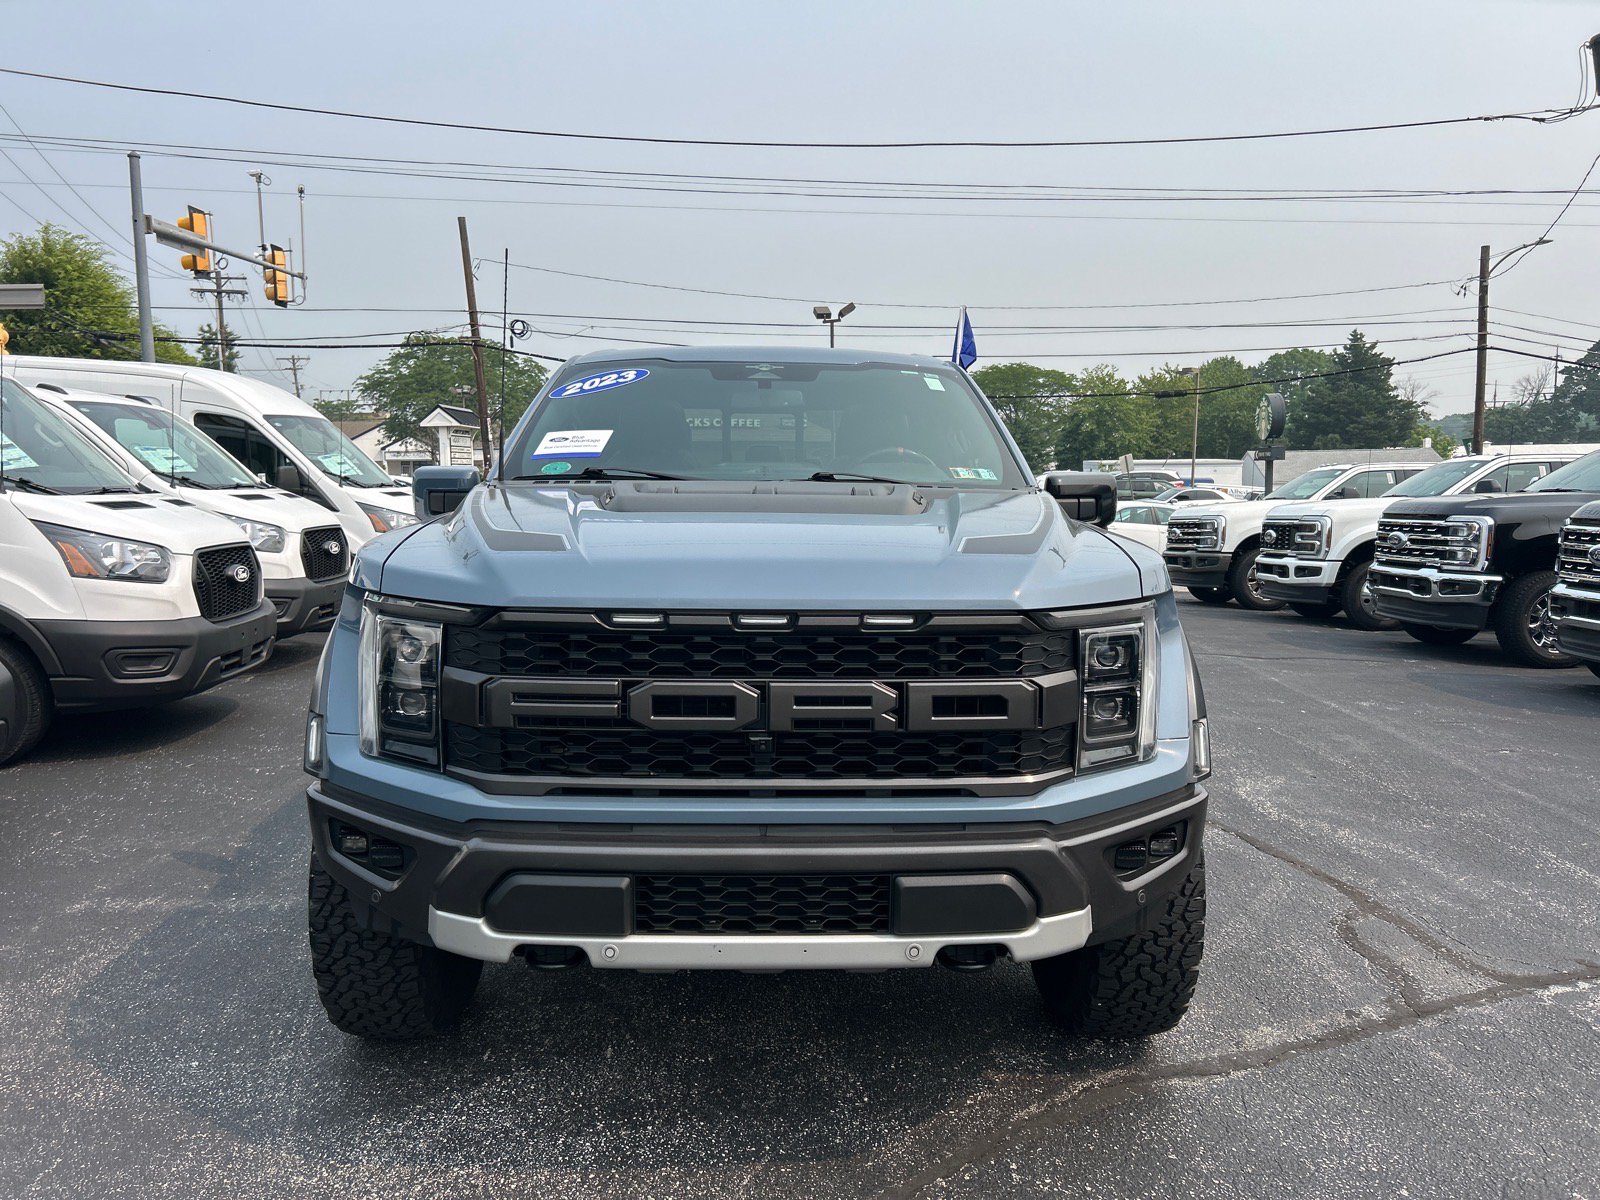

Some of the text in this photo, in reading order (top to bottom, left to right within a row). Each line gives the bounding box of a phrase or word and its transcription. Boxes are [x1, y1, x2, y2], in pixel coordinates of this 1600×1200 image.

[561, 370, 637, 397] 2023
[713, 418, 761, 427] CFFEE
[482, 678, 1042, 732] FORD
